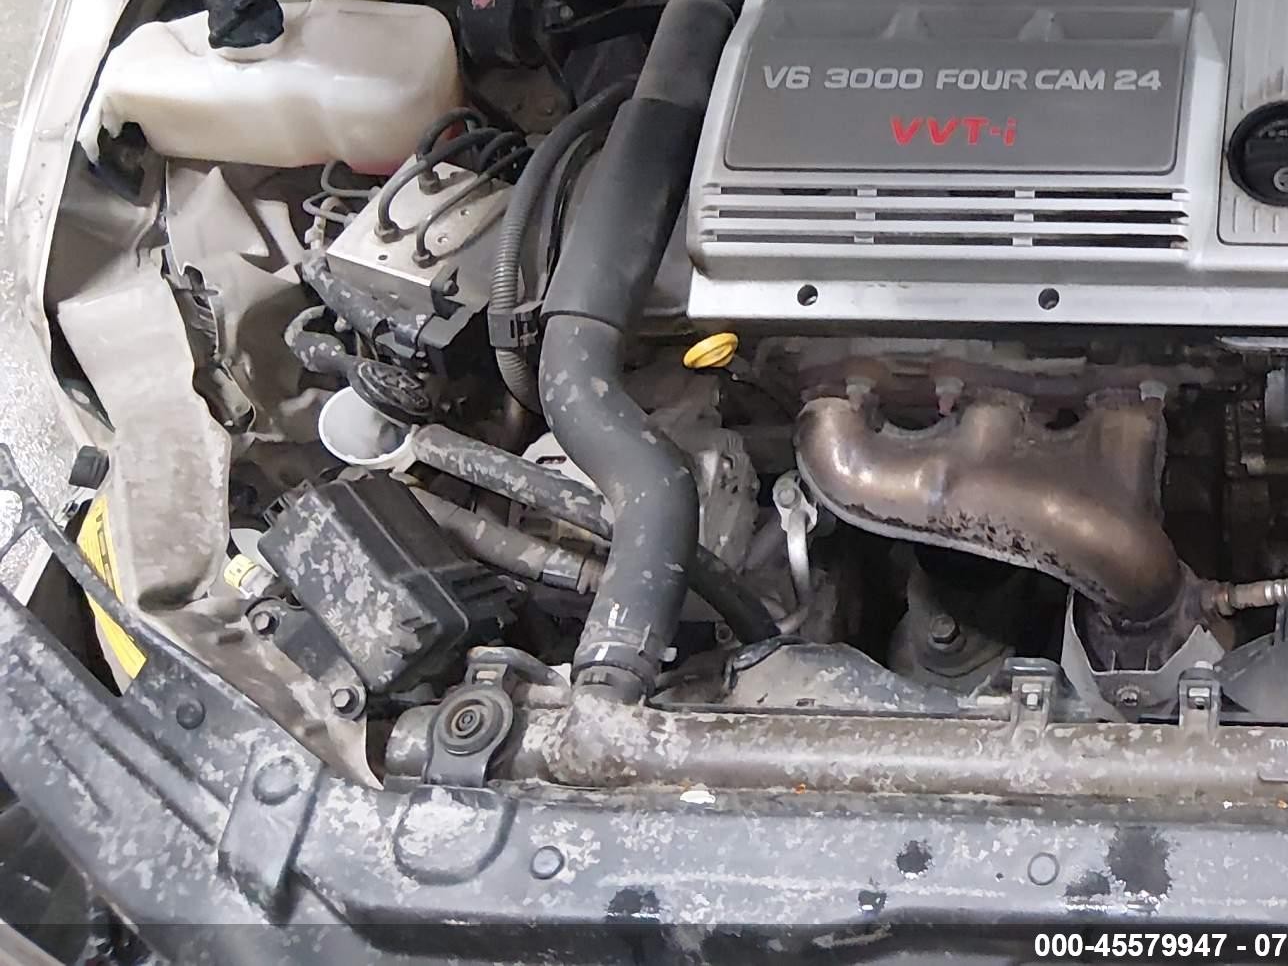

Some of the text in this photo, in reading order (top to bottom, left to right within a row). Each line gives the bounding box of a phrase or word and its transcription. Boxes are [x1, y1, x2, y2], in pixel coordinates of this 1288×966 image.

[762, 65, 1162, 91] V6 3000 FOUR CAM 24
[889, 116, 1018, 146] VVT-i
